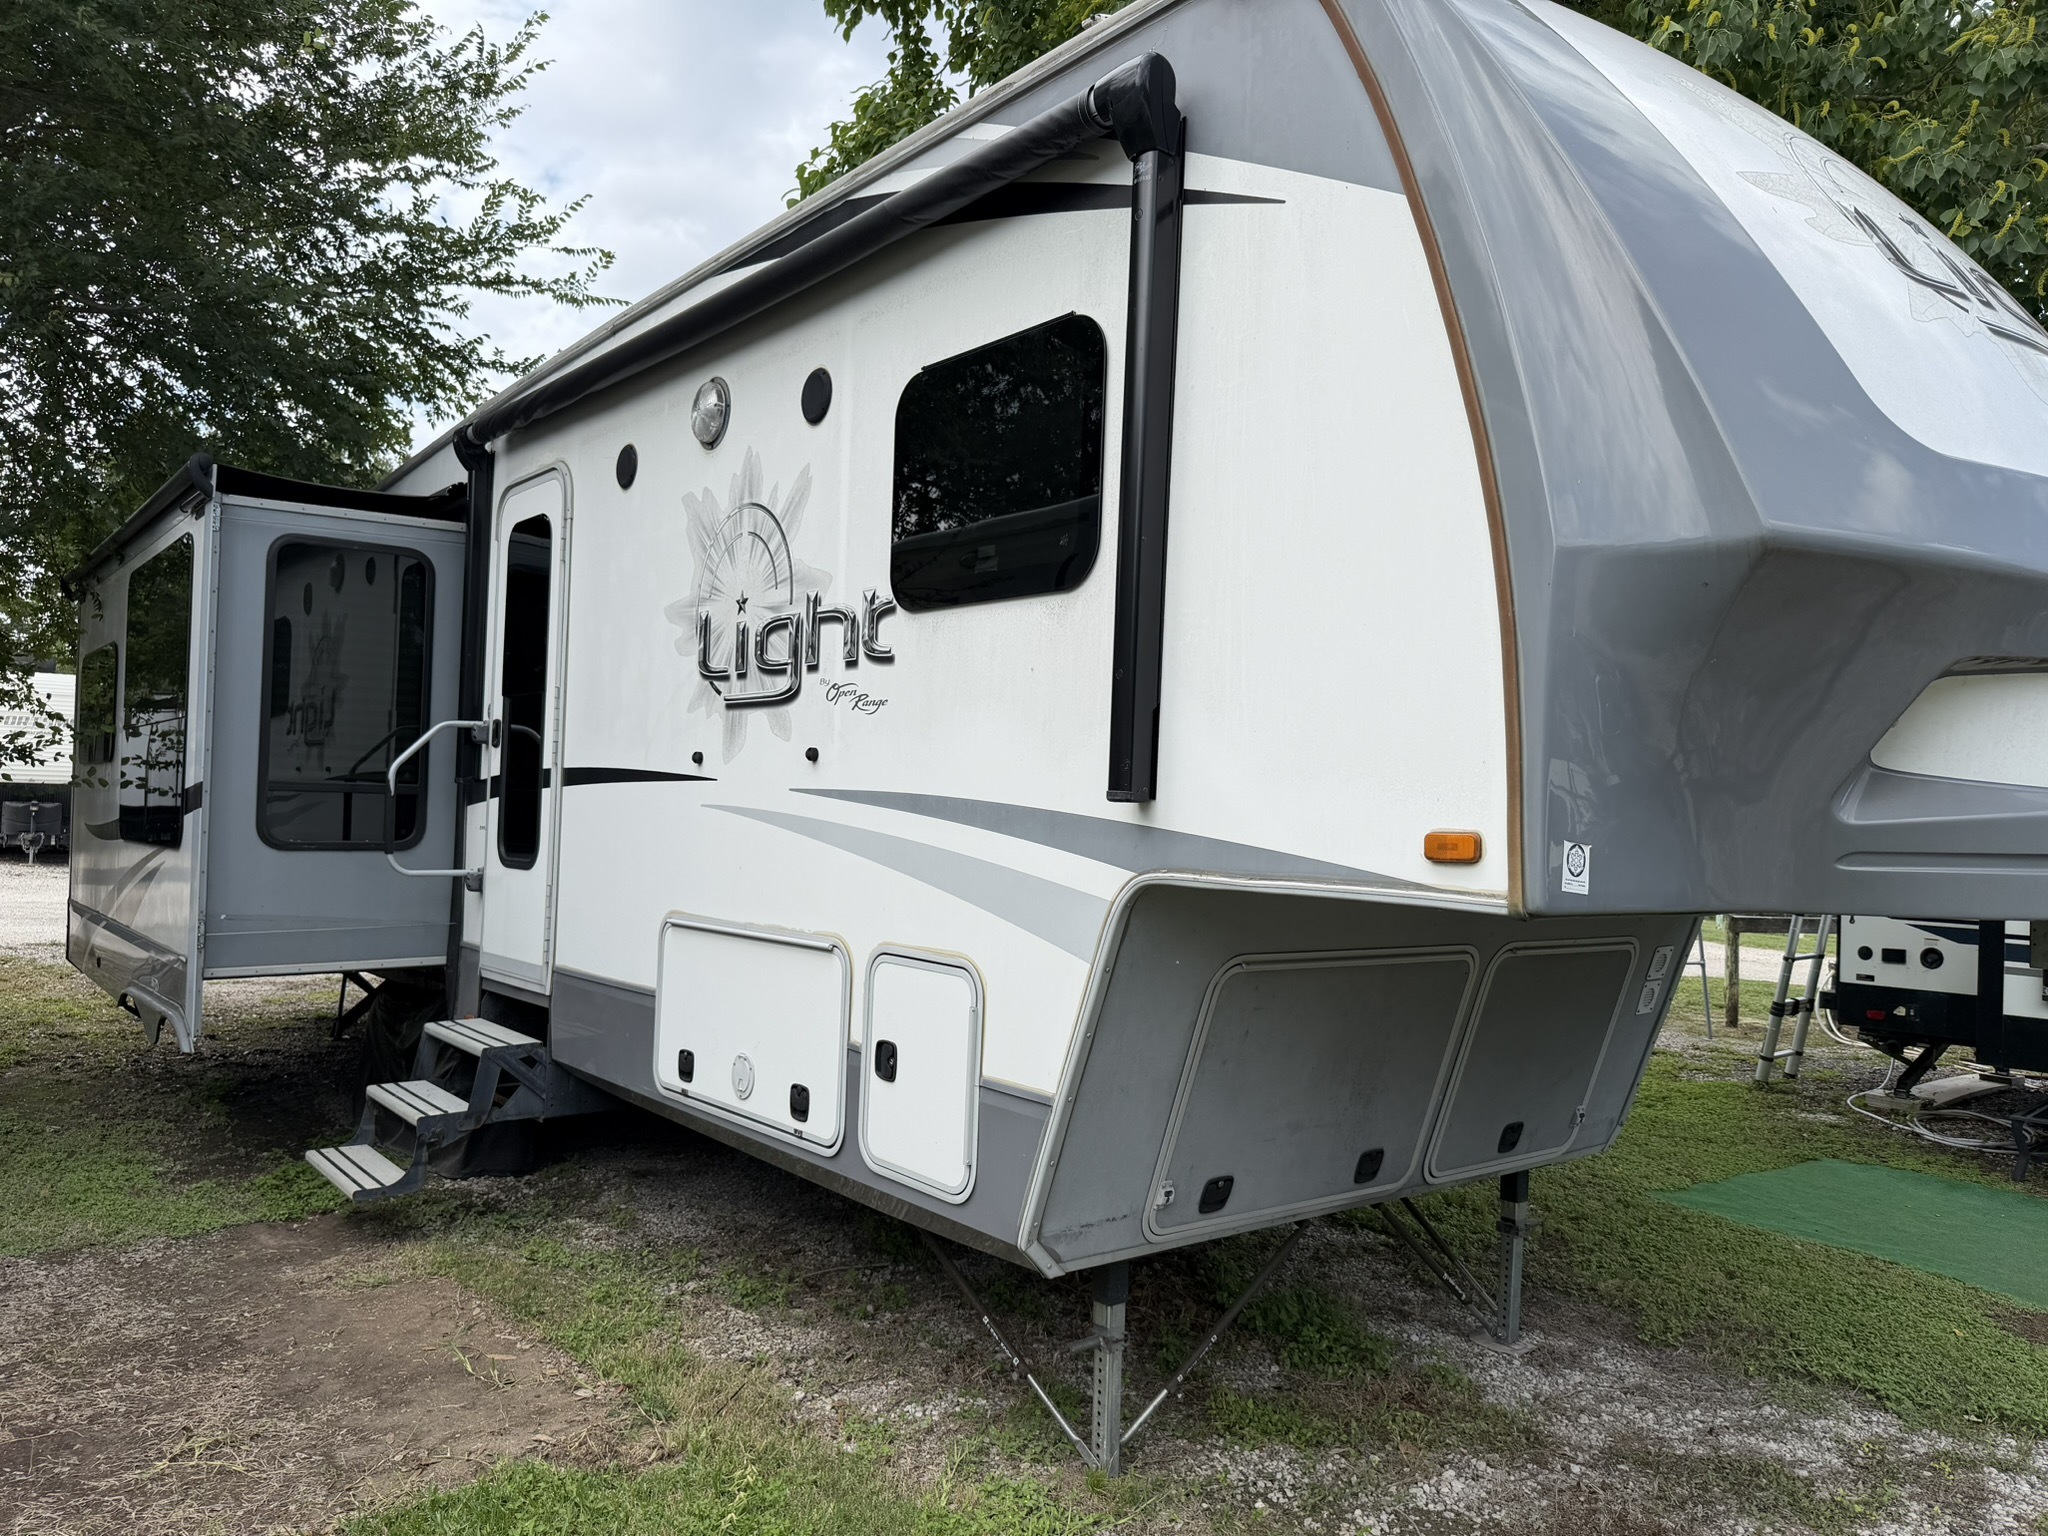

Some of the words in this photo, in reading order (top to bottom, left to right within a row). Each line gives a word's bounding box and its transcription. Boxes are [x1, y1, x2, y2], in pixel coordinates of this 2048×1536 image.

[698, 589, 897, 704] Light
[819, 677, 831, 687] By
[826, 683, 859, 706] Open
[848, 693, 889, 716] Range
